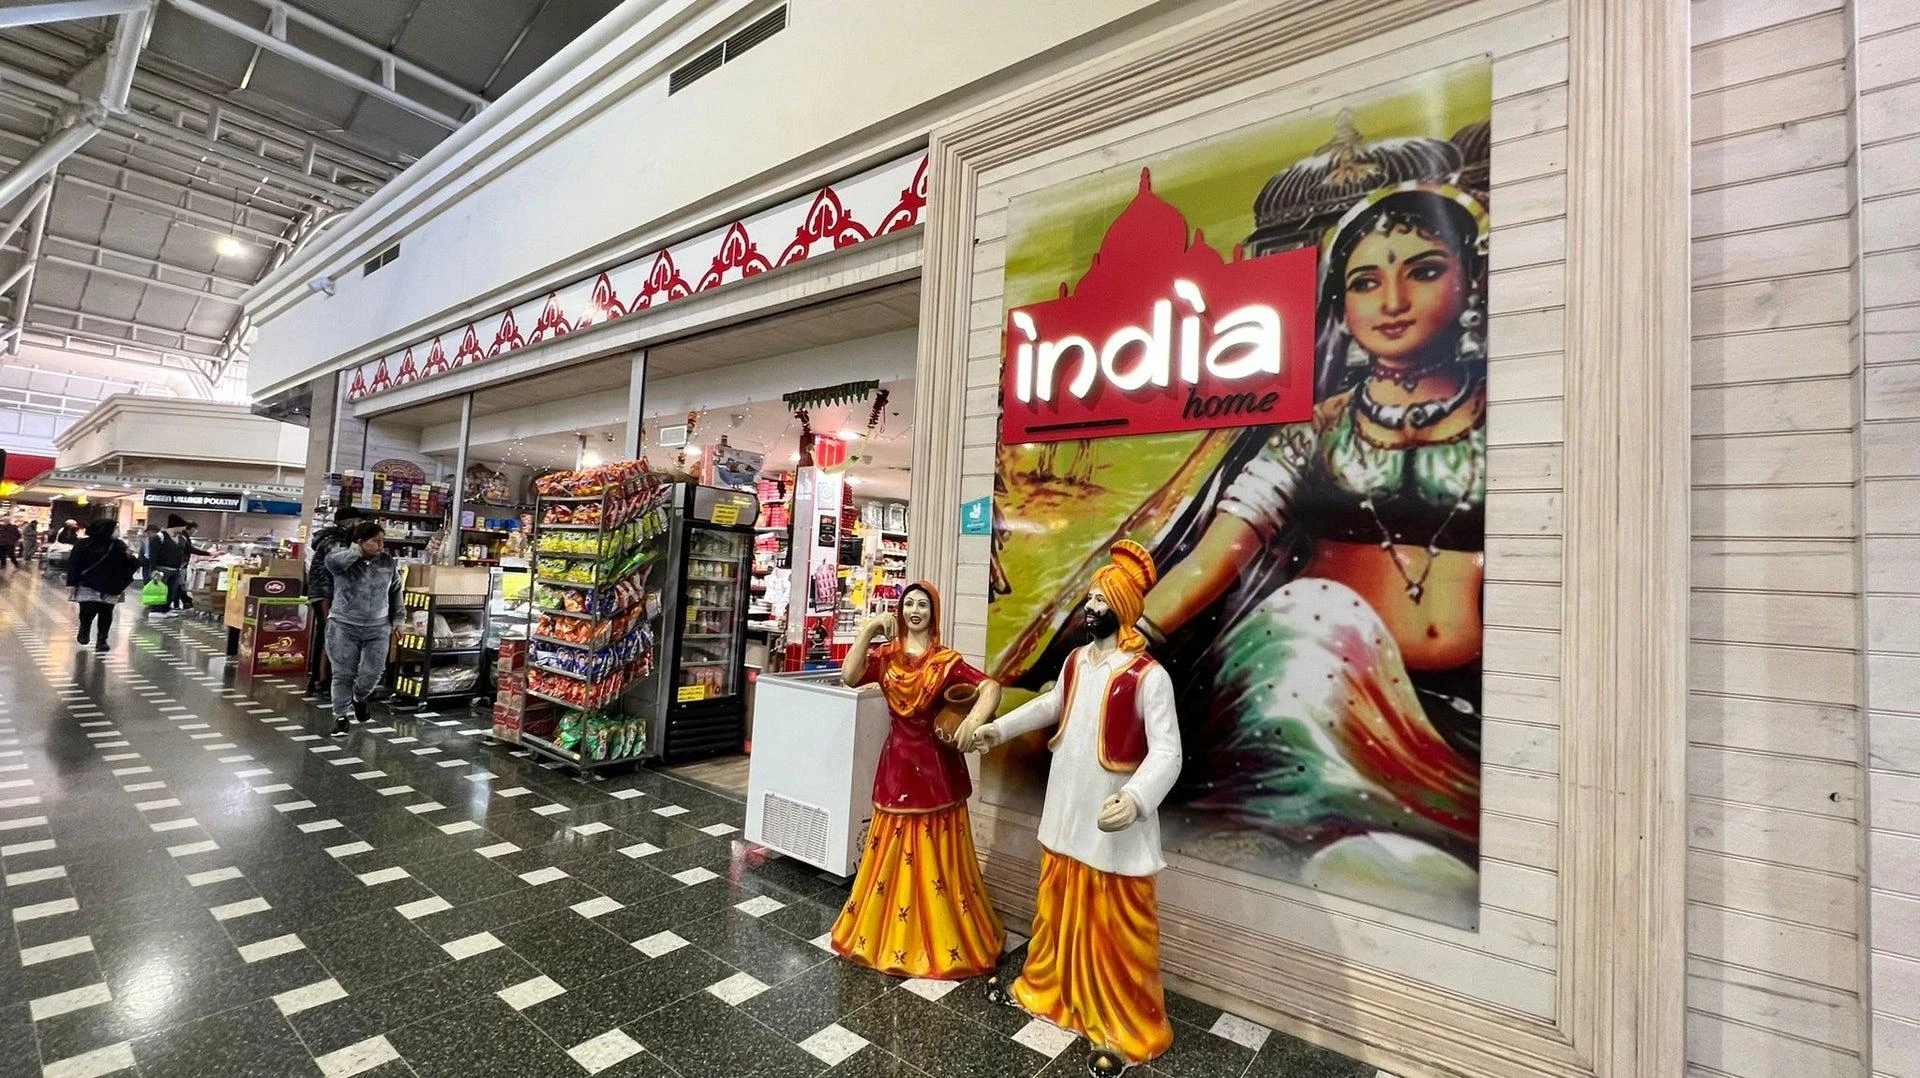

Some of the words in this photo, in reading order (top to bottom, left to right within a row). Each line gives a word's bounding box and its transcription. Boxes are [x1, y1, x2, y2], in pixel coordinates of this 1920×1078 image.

[1012, 279, 1281, 403] india
[1182, 387, 1279, 421] home
[145, 494, 172, 503] GREEN
[173, 495, 203, 504] VILLAGE
[204, 497, 240, 507] POULTRY
